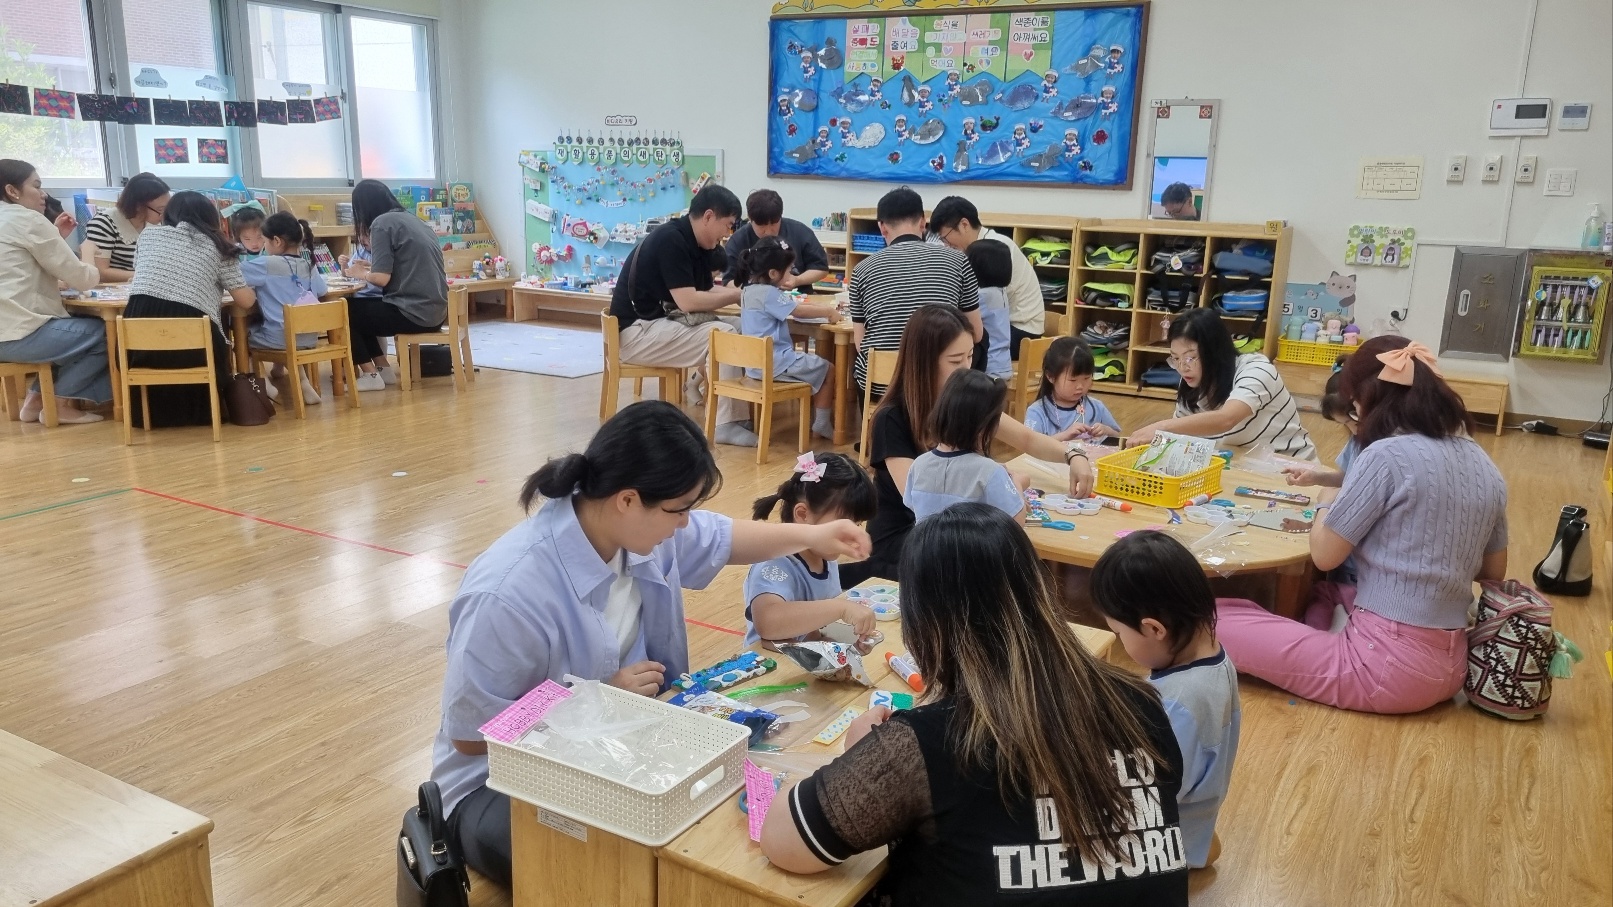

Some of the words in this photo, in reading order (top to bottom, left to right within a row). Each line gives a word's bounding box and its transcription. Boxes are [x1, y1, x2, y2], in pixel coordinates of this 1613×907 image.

[1015, 16, 1049, 27] 색종이를
[892, 28, 918, 38] 배달을
[891, 40, 917, 50] 줄여요
[930, 59, 954, 68] 먹어요
[1282, 303, 1291, 314] 5
[1310, 308, 1319, 319] 3
[993, 845, 1071, 888] THE
